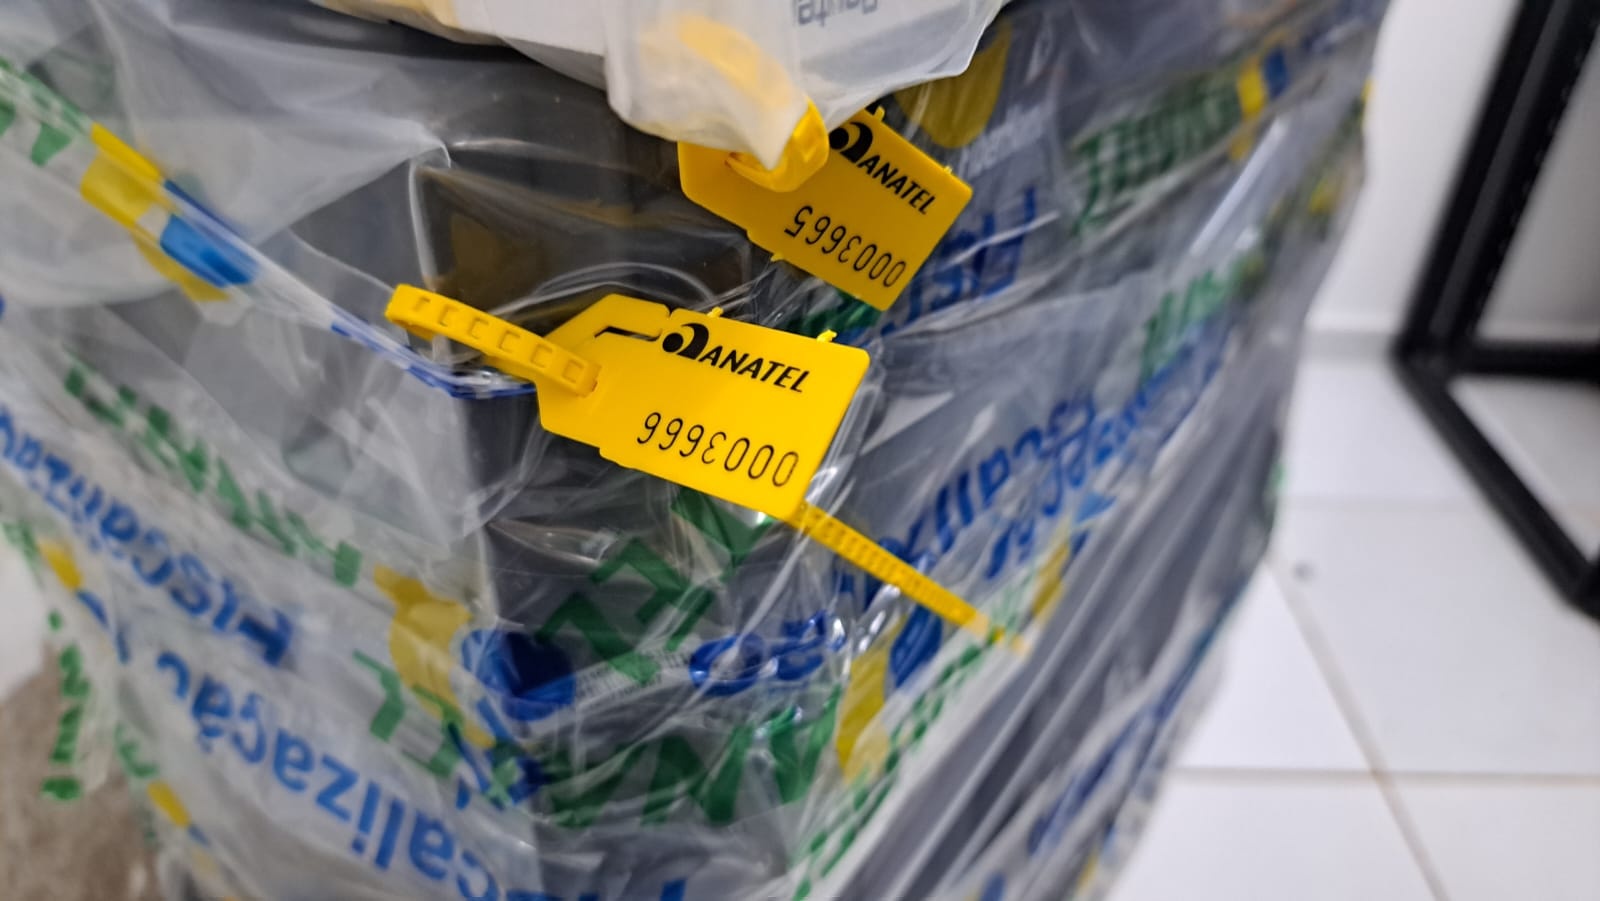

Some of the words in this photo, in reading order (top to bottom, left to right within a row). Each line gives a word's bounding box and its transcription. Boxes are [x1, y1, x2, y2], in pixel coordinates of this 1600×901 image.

[857, 154, 936, 215] ANATEL
[783, 205, 907, 288] 0003665
[697, 345, 810, 393] ANATEL
[636, 411, 799, 487] 0003666
